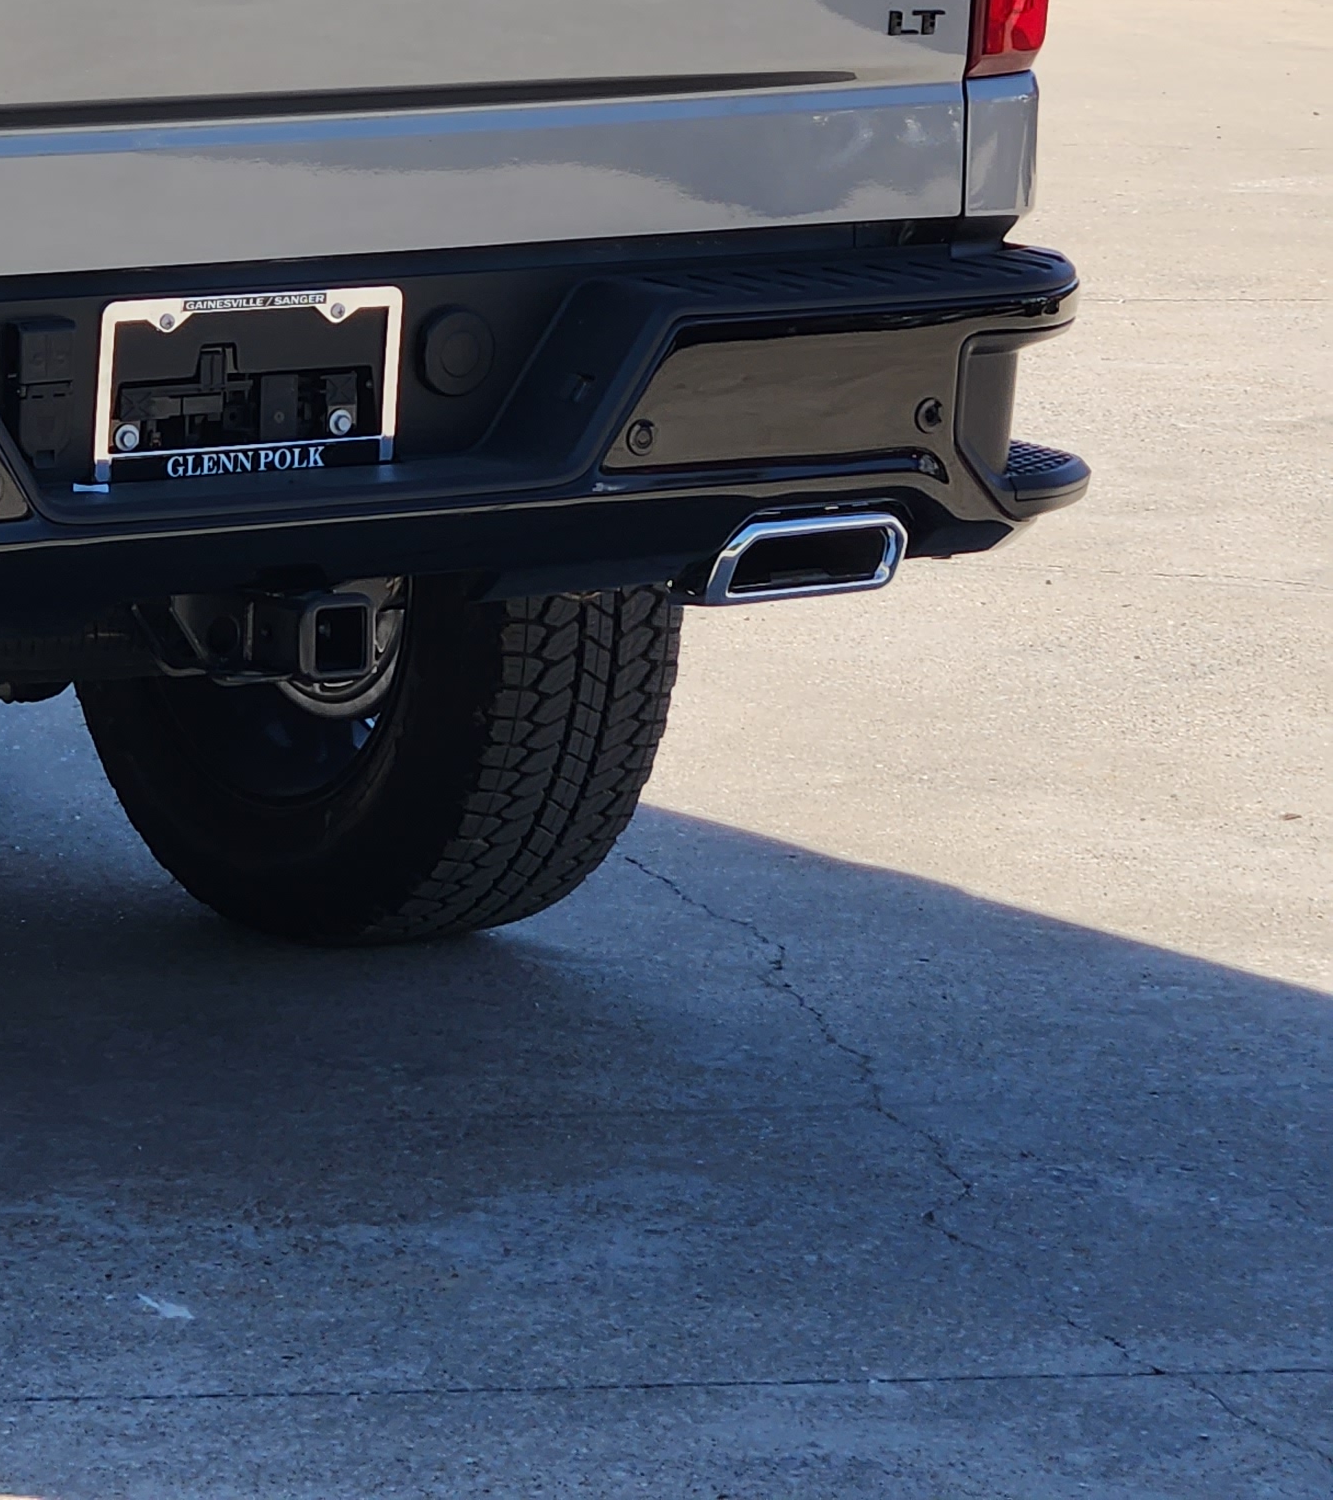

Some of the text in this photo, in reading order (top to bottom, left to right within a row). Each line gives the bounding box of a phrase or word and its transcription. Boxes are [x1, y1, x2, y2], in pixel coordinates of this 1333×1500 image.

[887, 9, 946, 36] LT
[185, 297, 264, 310] GAINESVILLE
[274, 294, 325, 305] SANGER
[166, 446, 325, 477] GLENN POLK
